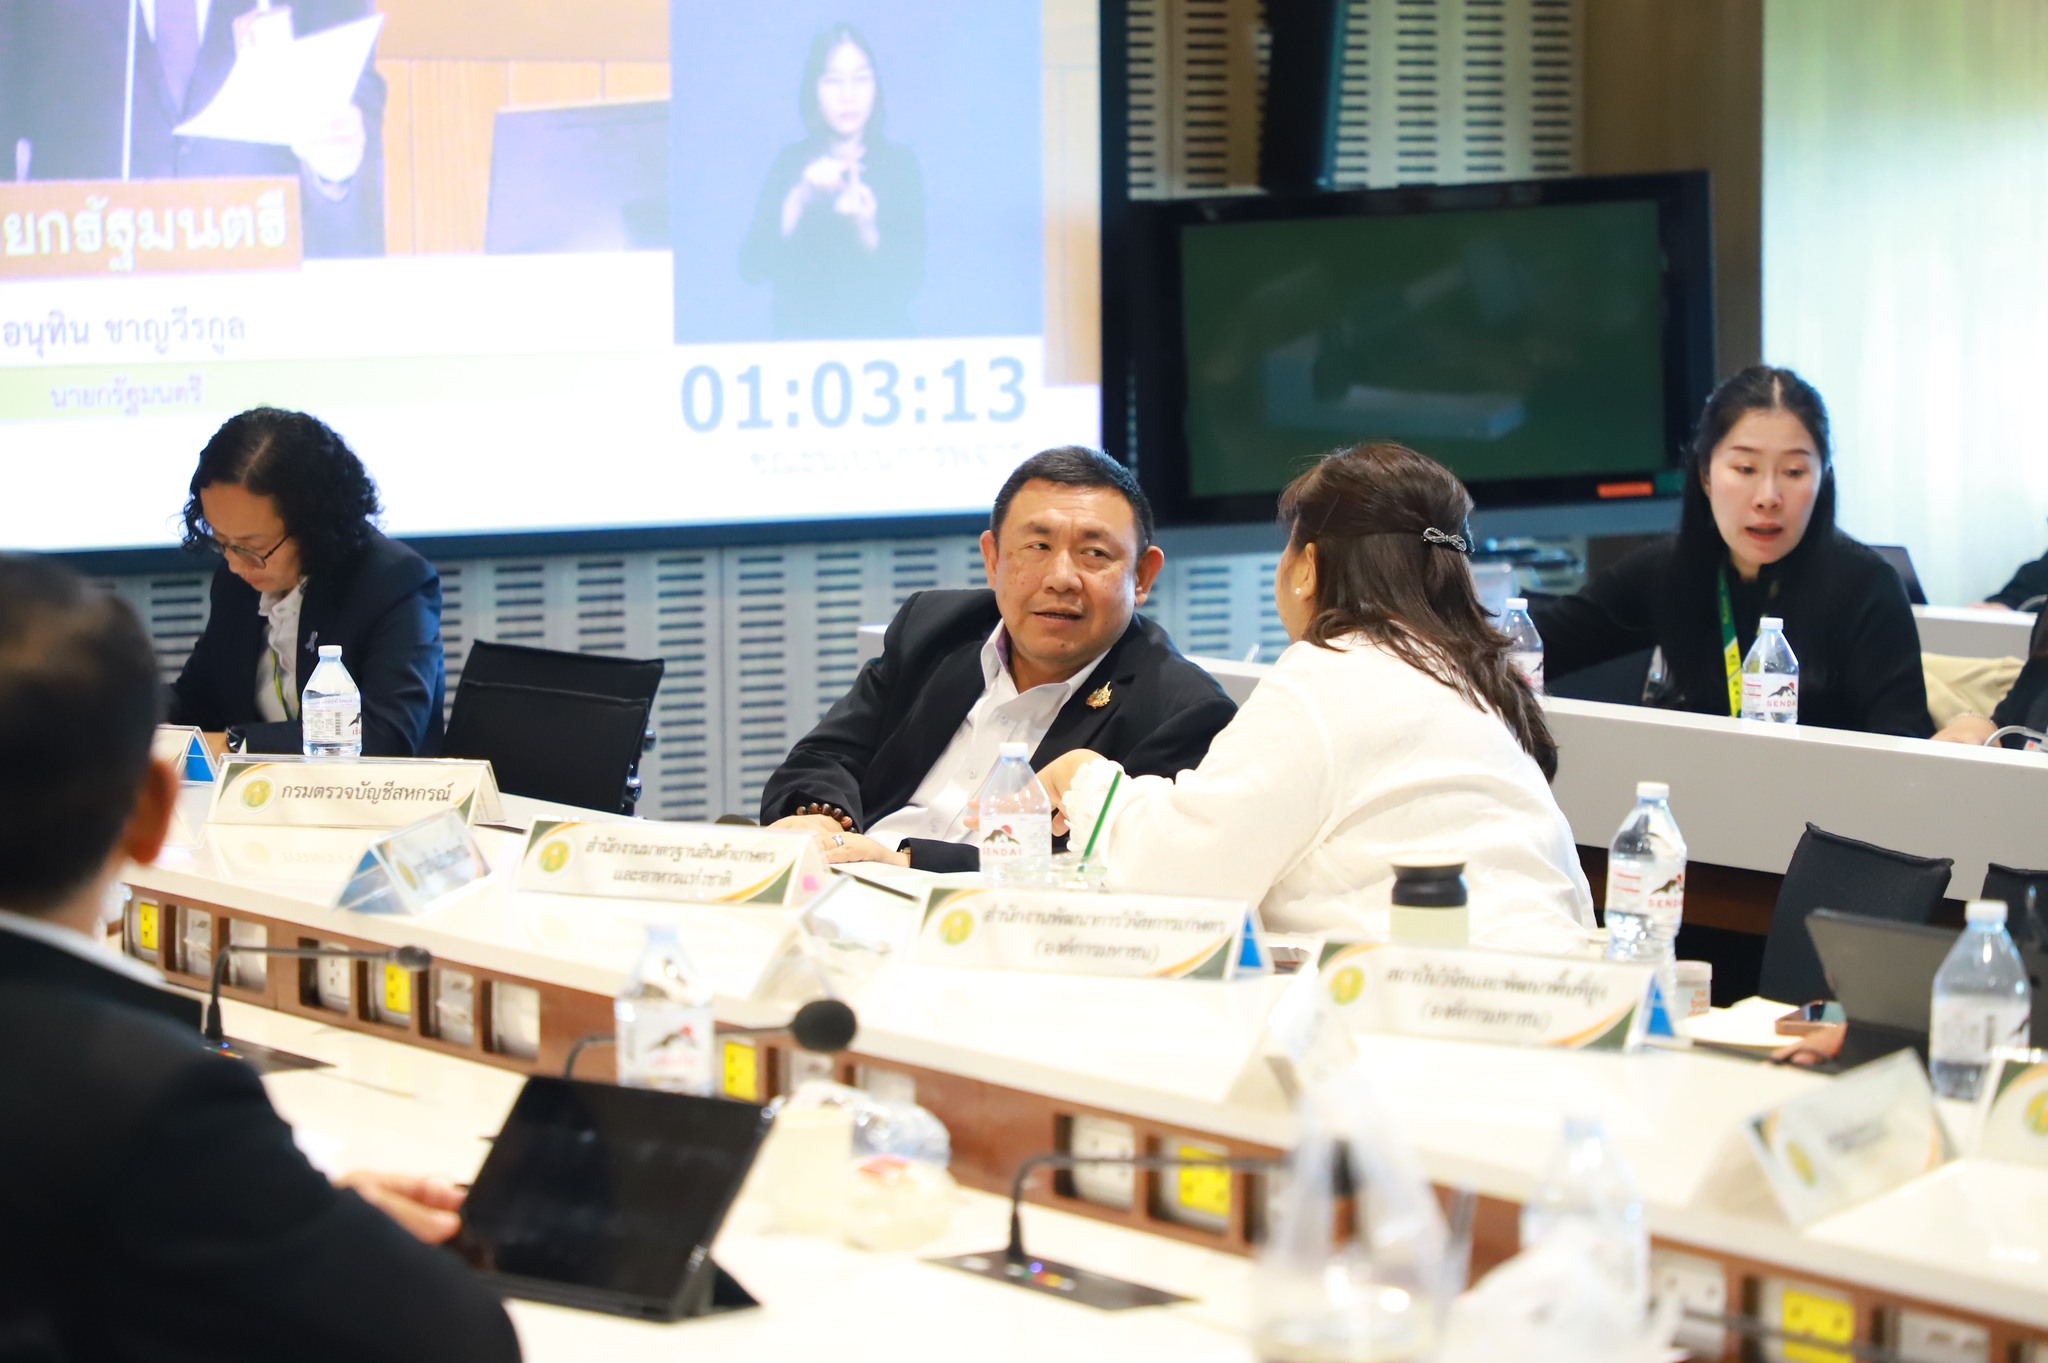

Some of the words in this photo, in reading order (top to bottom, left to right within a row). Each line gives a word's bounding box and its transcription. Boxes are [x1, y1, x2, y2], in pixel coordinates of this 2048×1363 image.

[3, 309, 90, 358] อนุทิน
[104, 305, 246, 355] ชาญวีรกูล
[50, 374, 203, 416] นายกรัฐมนตรี
[680, 355, 1027, 433] 01:03:13
[281, 780, 455, 805] กรมตรวจบัญชีสหกรณ์
